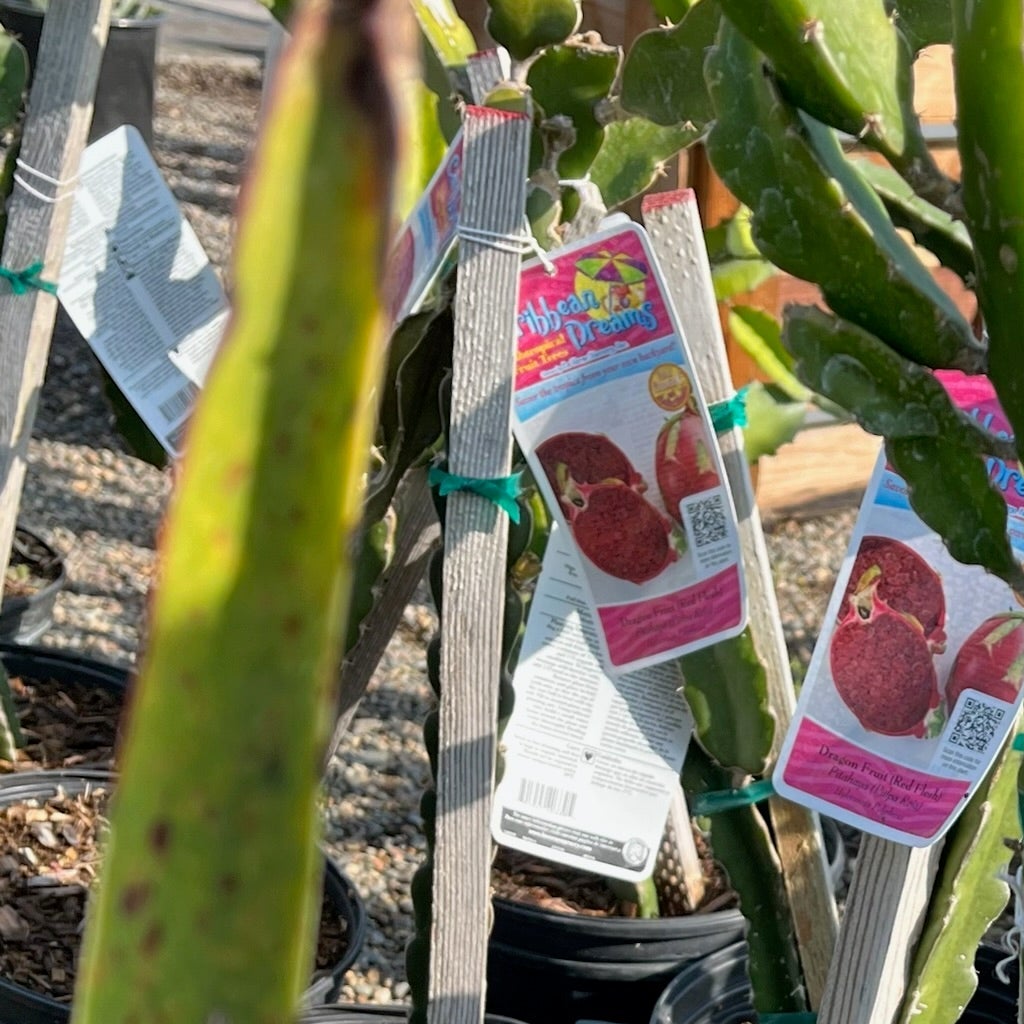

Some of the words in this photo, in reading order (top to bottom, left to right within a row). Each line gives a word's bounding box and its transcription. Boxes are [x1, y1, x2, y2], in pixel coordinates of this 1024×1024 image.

[516, 290, 598, 336] ribbean
[565, 301, 658, 349] Dreams
[516, 359, 538, 374] ruit
[538, 347, 569, 365] Trees
[882, 478, 912, 495] Savo
[816, 742, 861, 773] Dragon
[859, 758, 890, 781] Fruit
[888, 770, 915, 794] (Red
[912, 779, 944, 805] Flesh)
